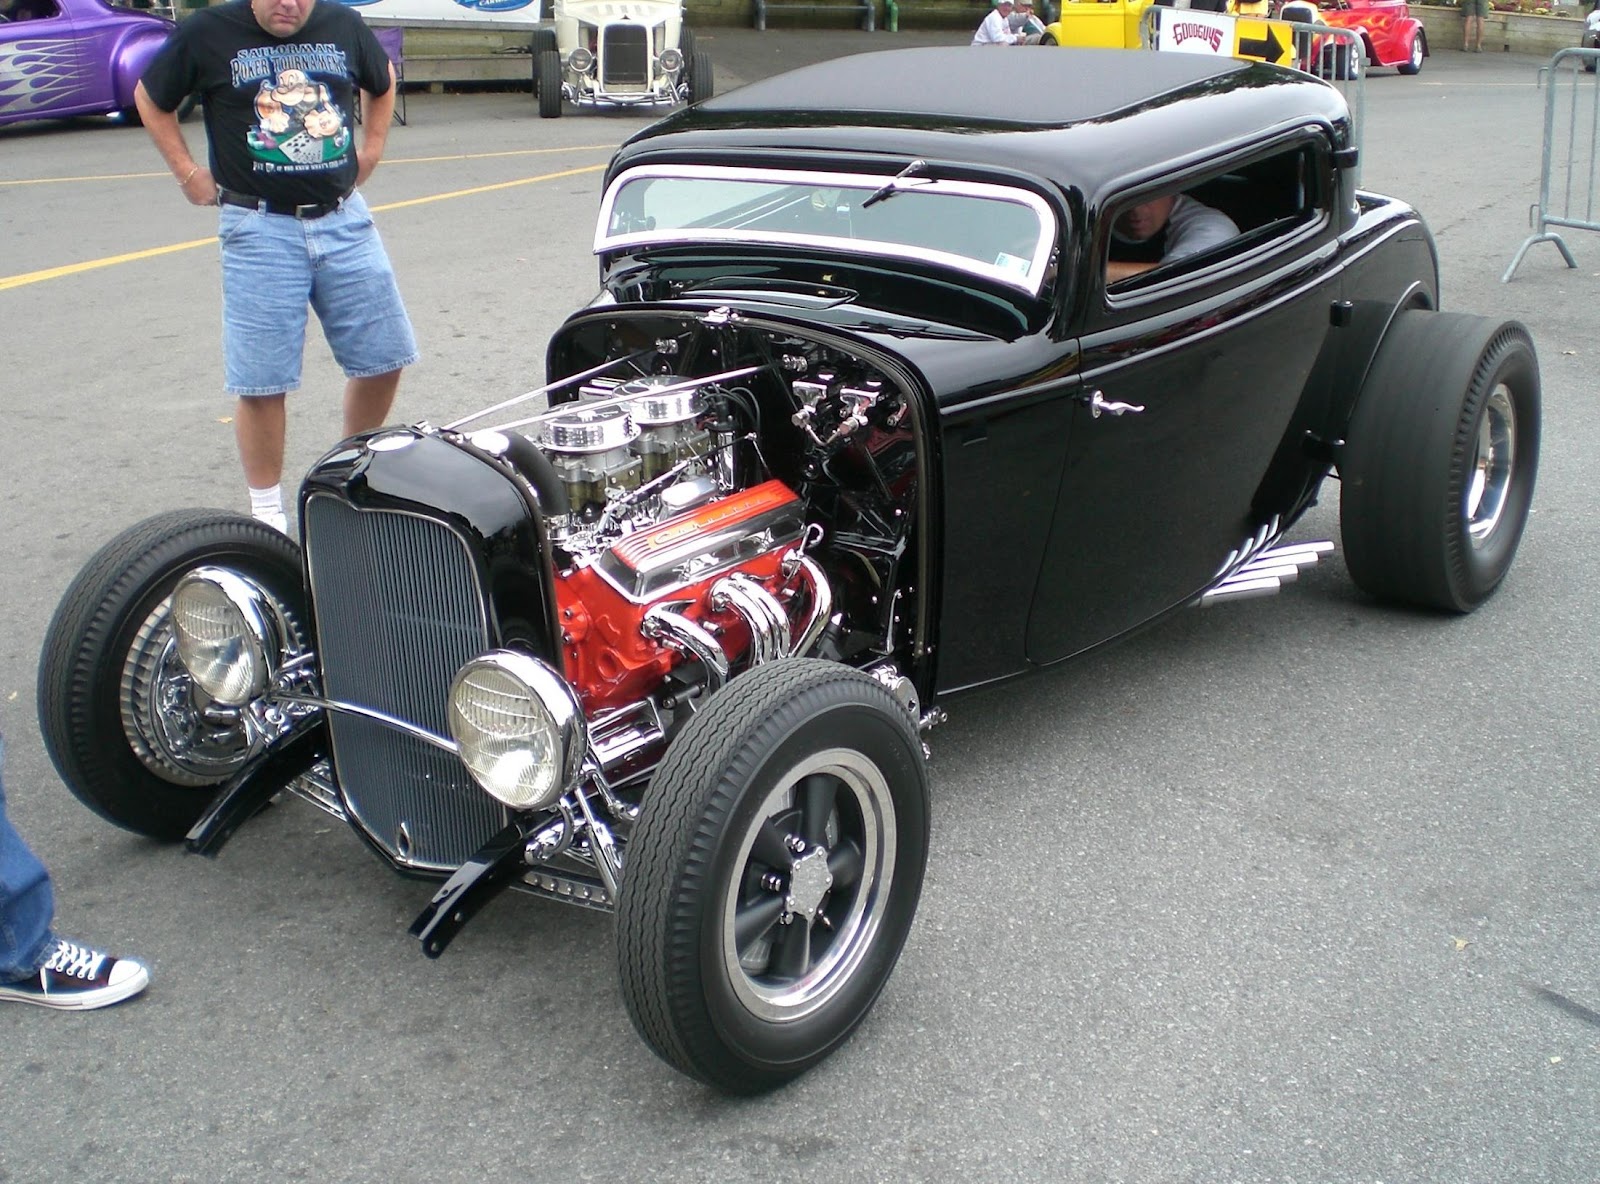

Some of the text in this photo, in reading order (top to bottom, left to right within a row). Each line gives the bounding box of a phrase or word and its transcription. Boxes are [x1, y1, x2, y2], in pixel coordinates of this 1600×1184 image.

[236, 43, 346, 60] SAILORMAN
[1172, 22, 1224, 53] GOODGUYS
[229, 54, 348, 88] POKER TOURNAMENT
